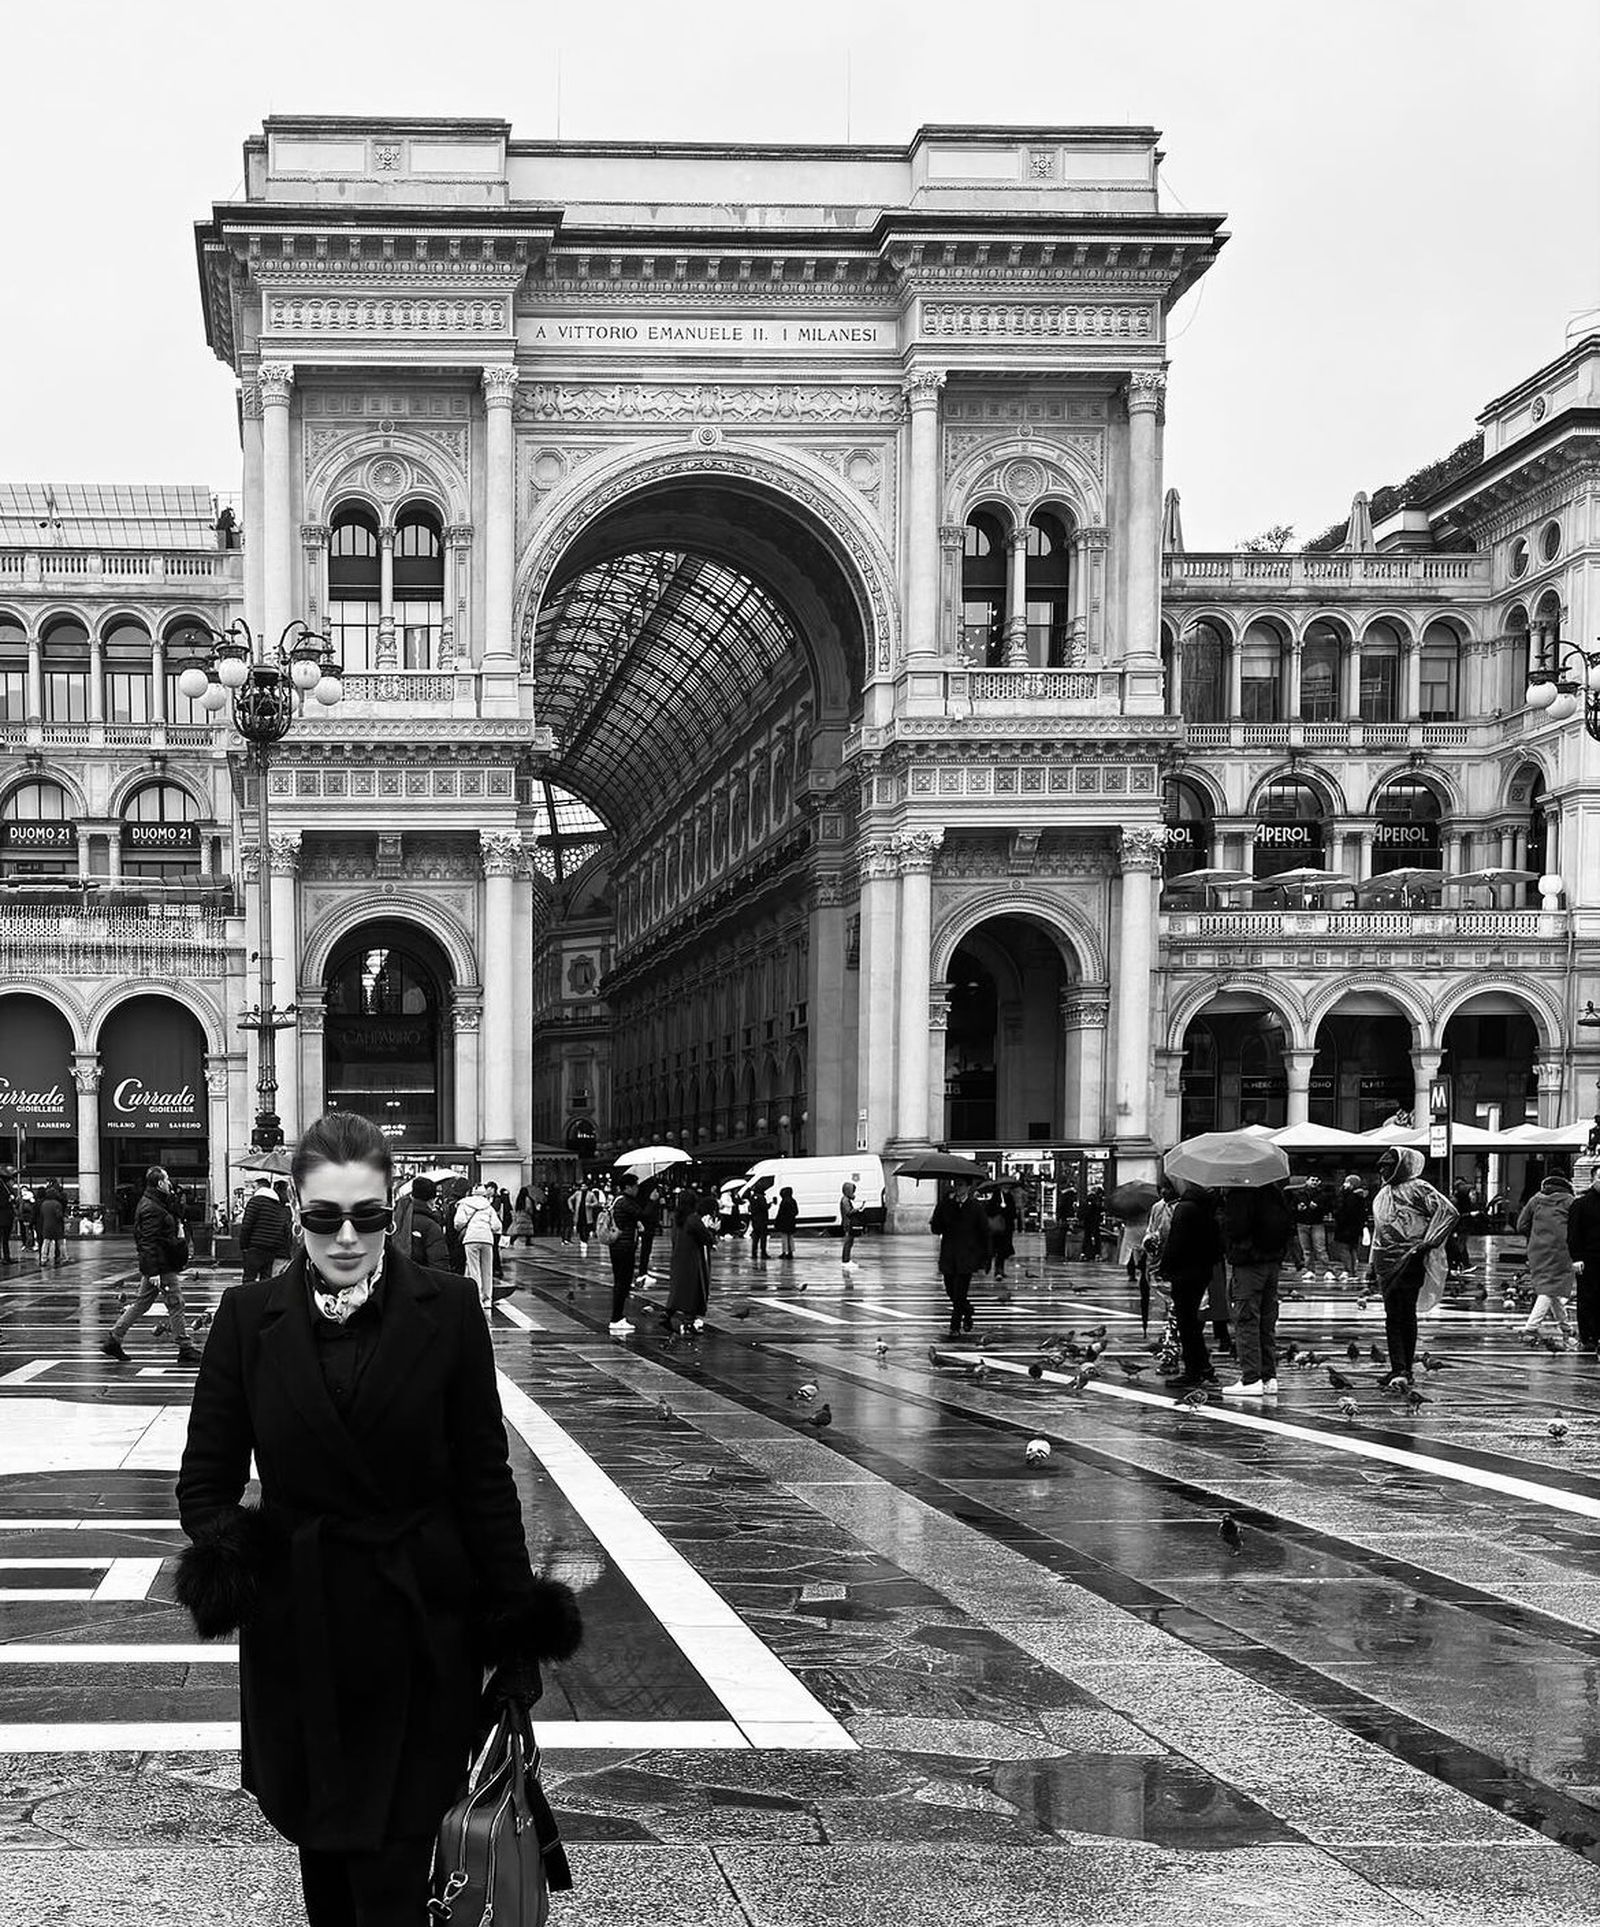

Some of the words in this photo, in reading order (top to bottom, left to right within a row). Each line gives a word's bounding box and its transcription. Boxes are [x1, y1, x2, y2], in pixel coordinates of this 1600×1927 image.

[536, 326, 546, 339] A
[558, 326, 638, 340] VITTORIO
[648, 326, 743, 341] EMANUELE
[783, 328, 787, 341] I
[798, 328, 877, 342] MILANESI
[10, 827, 55, 839] DUOMO
[57, 827, 70, 839] 21
[132, 827, 177, 840] DUOMO
[179, 828, 192, 839] 21
[1165, 827, 1194, 843] ROL
[1253, 823, 1312, 842] APEROL
[1372, 823, 1430, 842] APEROL
[1310, 1081, 1332, 1089] OMO
[113, 1078, 196, 1112] Currado
[1431, 1085, 1447, 1109] M
[16, 1105, 64, 1113] GIOIELLERIE
